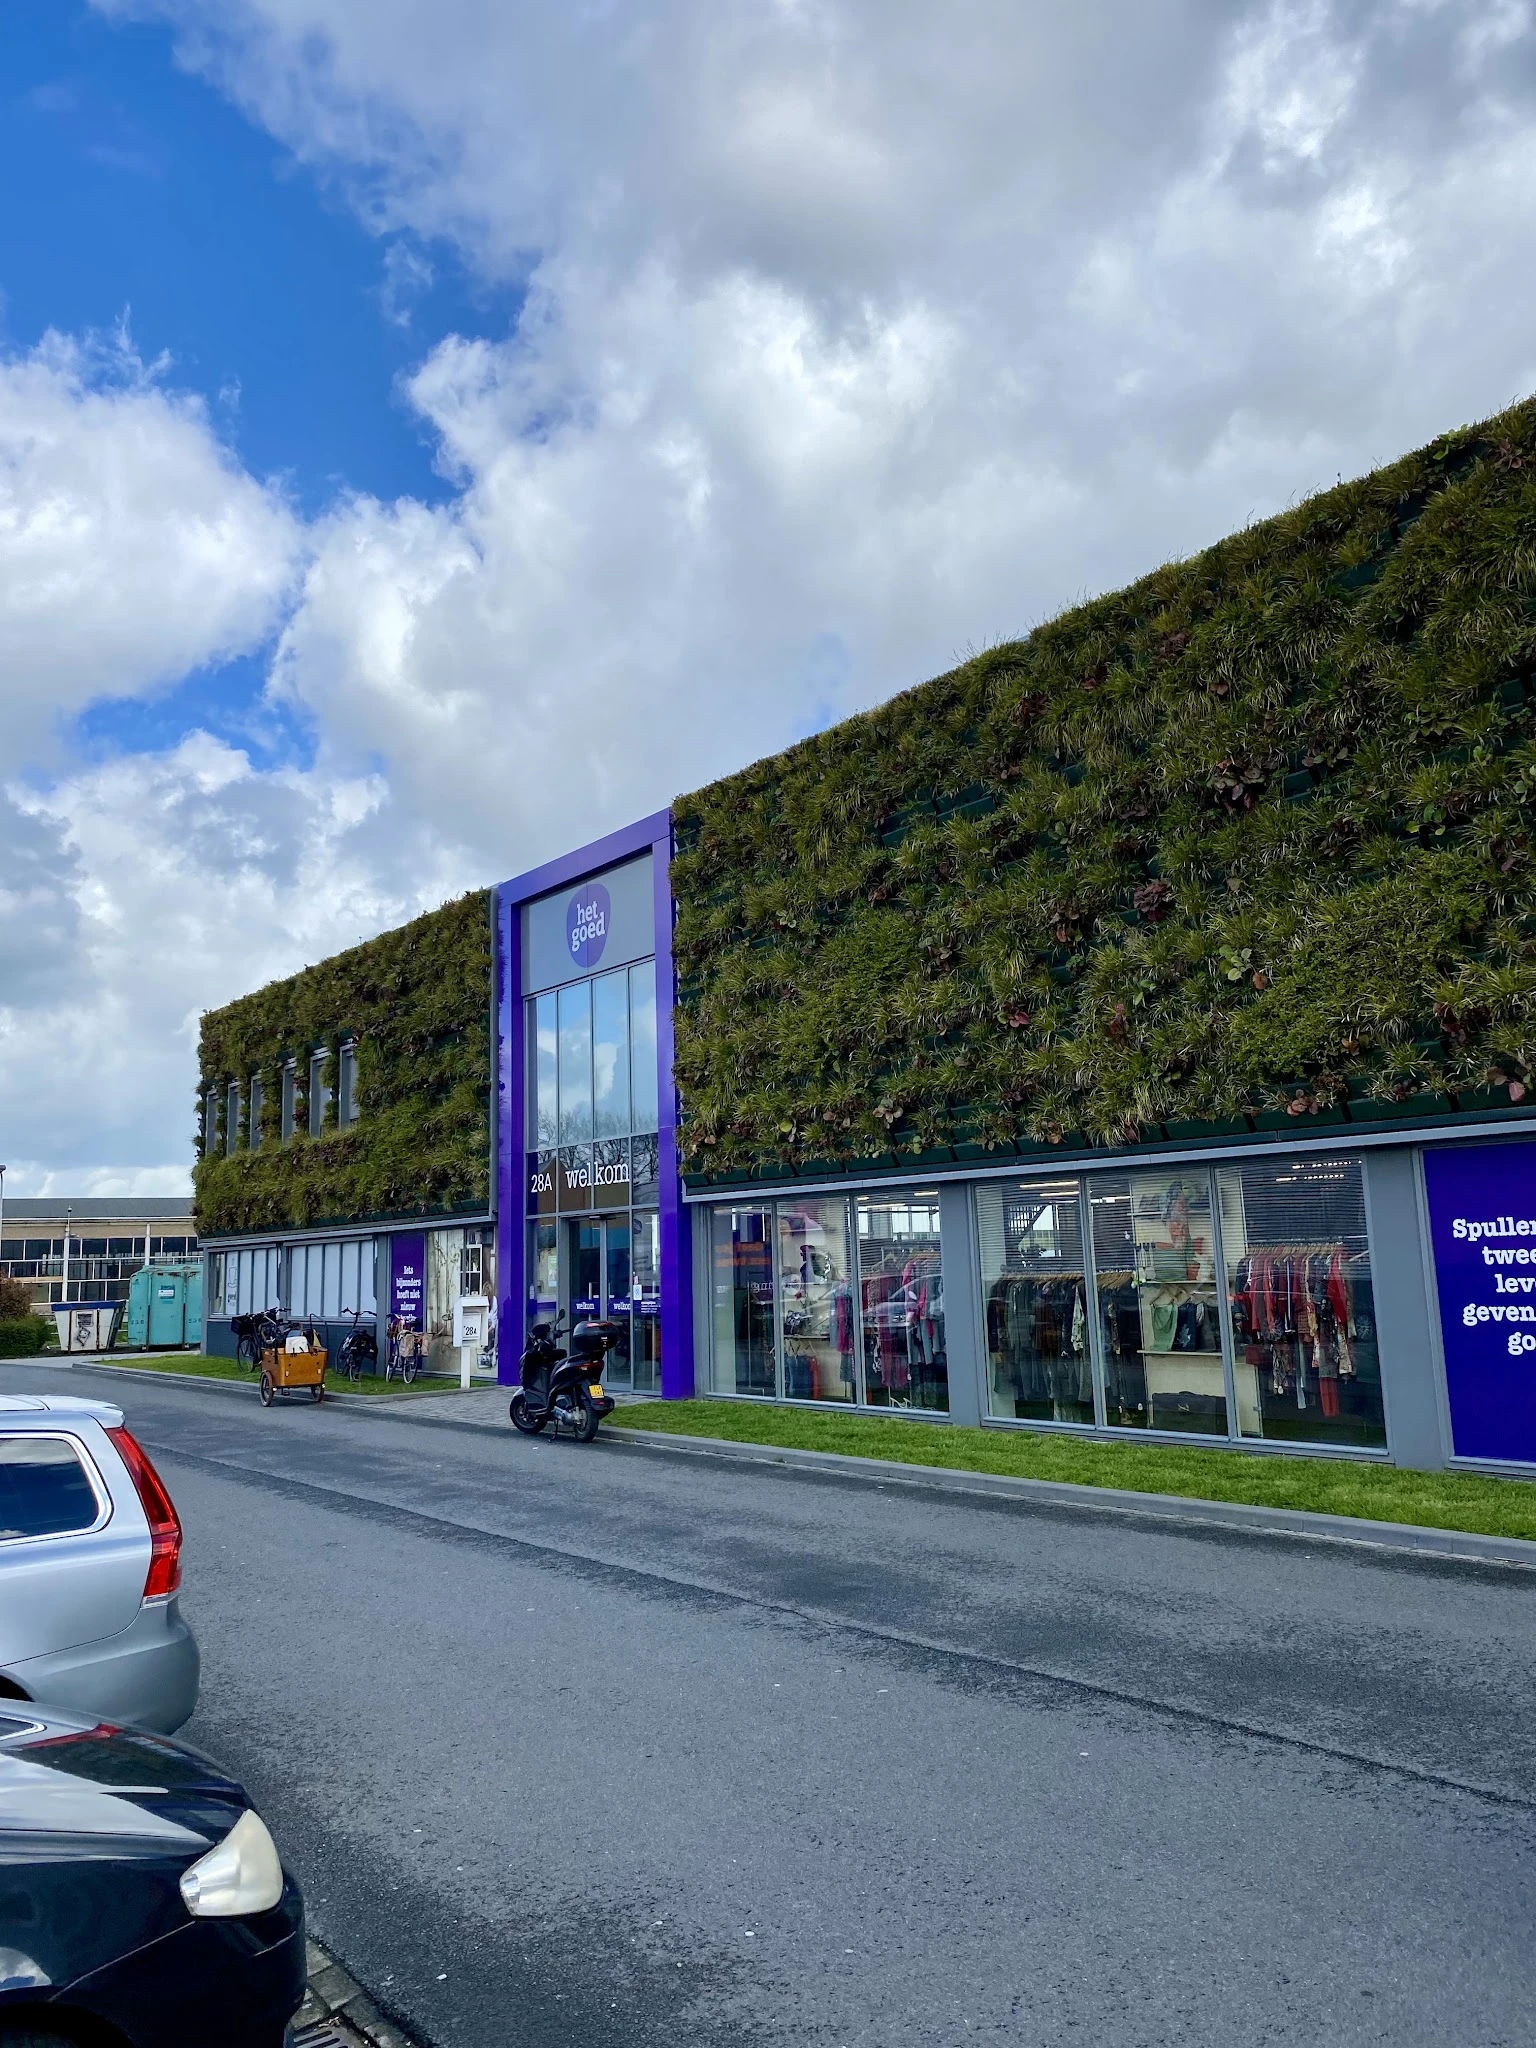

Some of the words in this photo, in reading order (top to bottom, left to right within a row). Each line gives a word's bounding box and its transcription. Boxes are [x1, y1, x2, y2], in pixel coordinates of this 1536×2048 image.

[576, 900, 599, 925] het
[571, 911, 606, 953] goed
[531, 1173, 553, 1193] 28A
[565, 1161, 630, 1189] welkom
[1494, 1273, 1536, 1293] lev
[1463, 1303, 1536, 1326] geven
[1508, 1332, 1536, 1355] go
